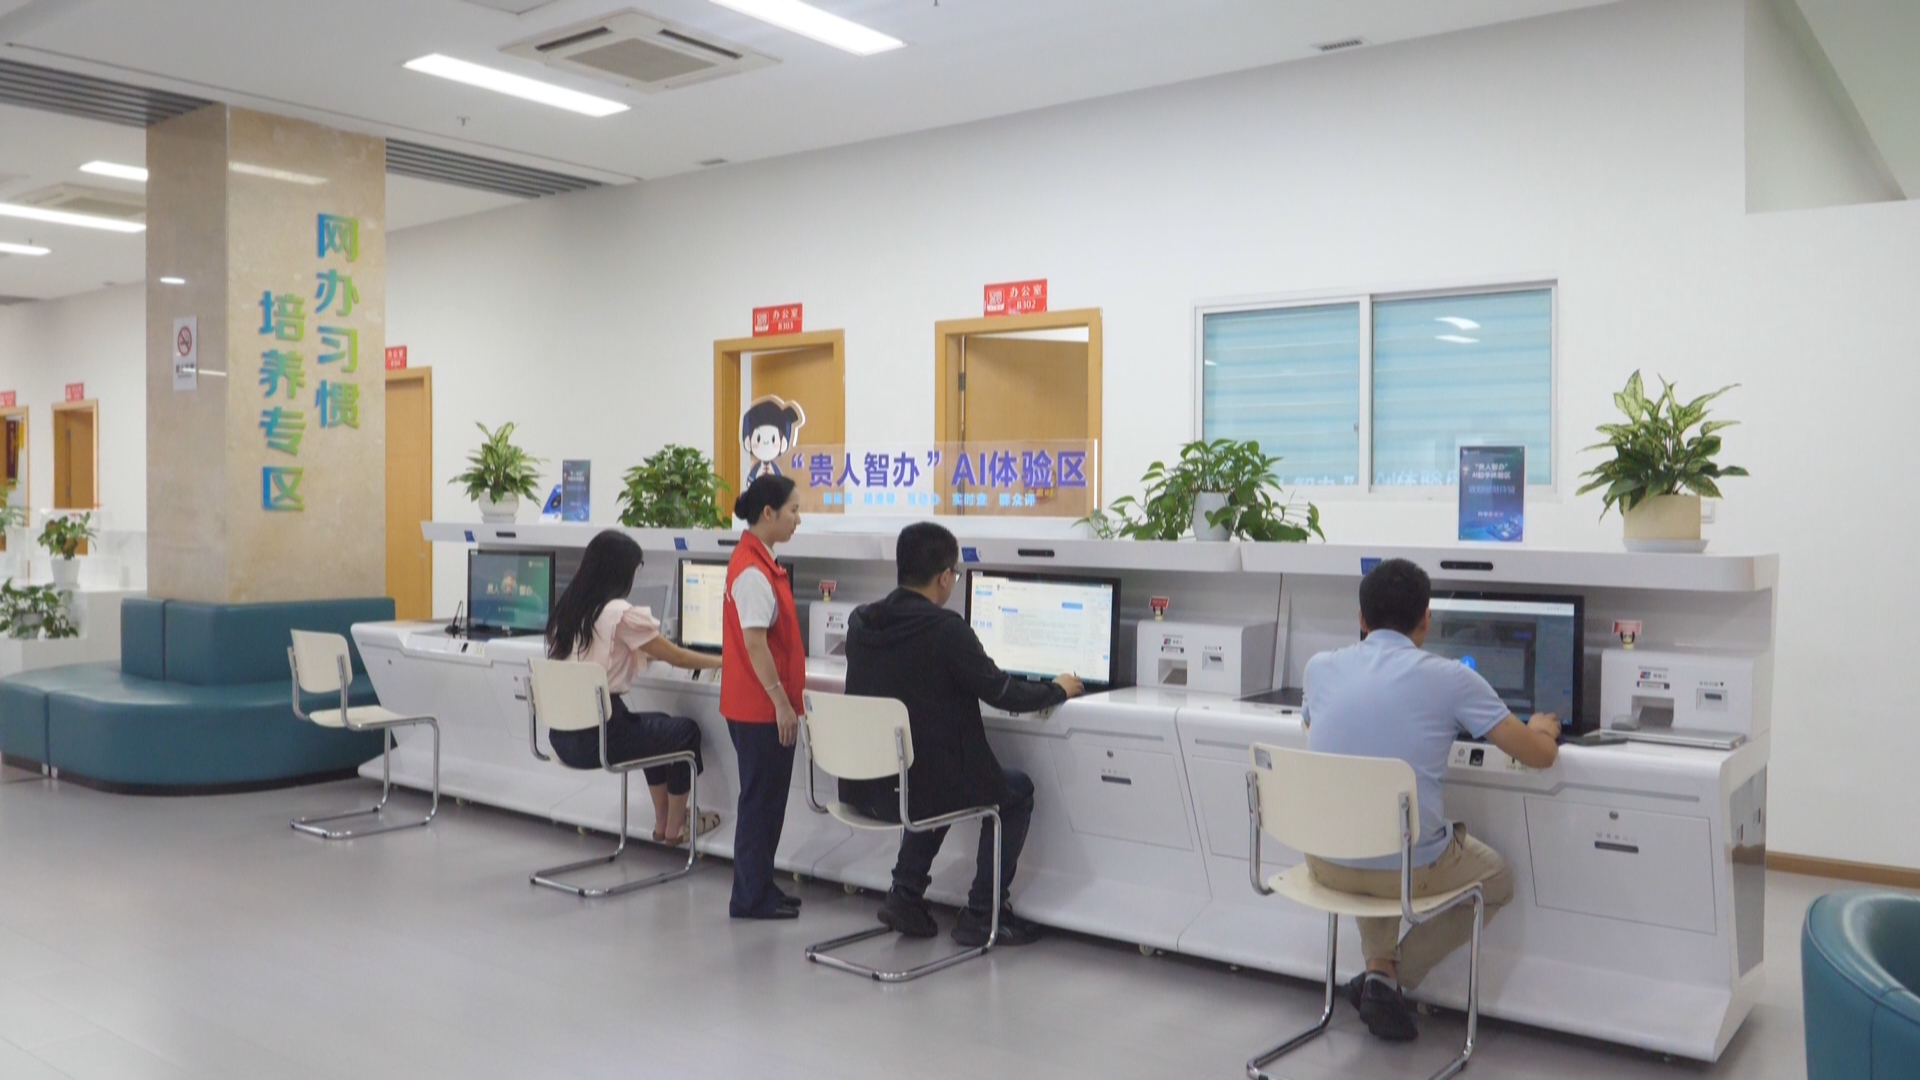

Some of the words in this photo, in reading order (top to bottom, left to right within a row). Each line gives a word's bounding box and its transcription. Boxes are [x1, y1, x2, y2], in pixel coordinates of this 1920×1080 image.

[1009, 284, 1043, 298] 办公室
[1016, 299, 1037, 311] B302
[772, 307, 799, 321] 办公室
[315, 213, 361, 430] 网办习惯
[259, 290, 307, 512] 培养专区
